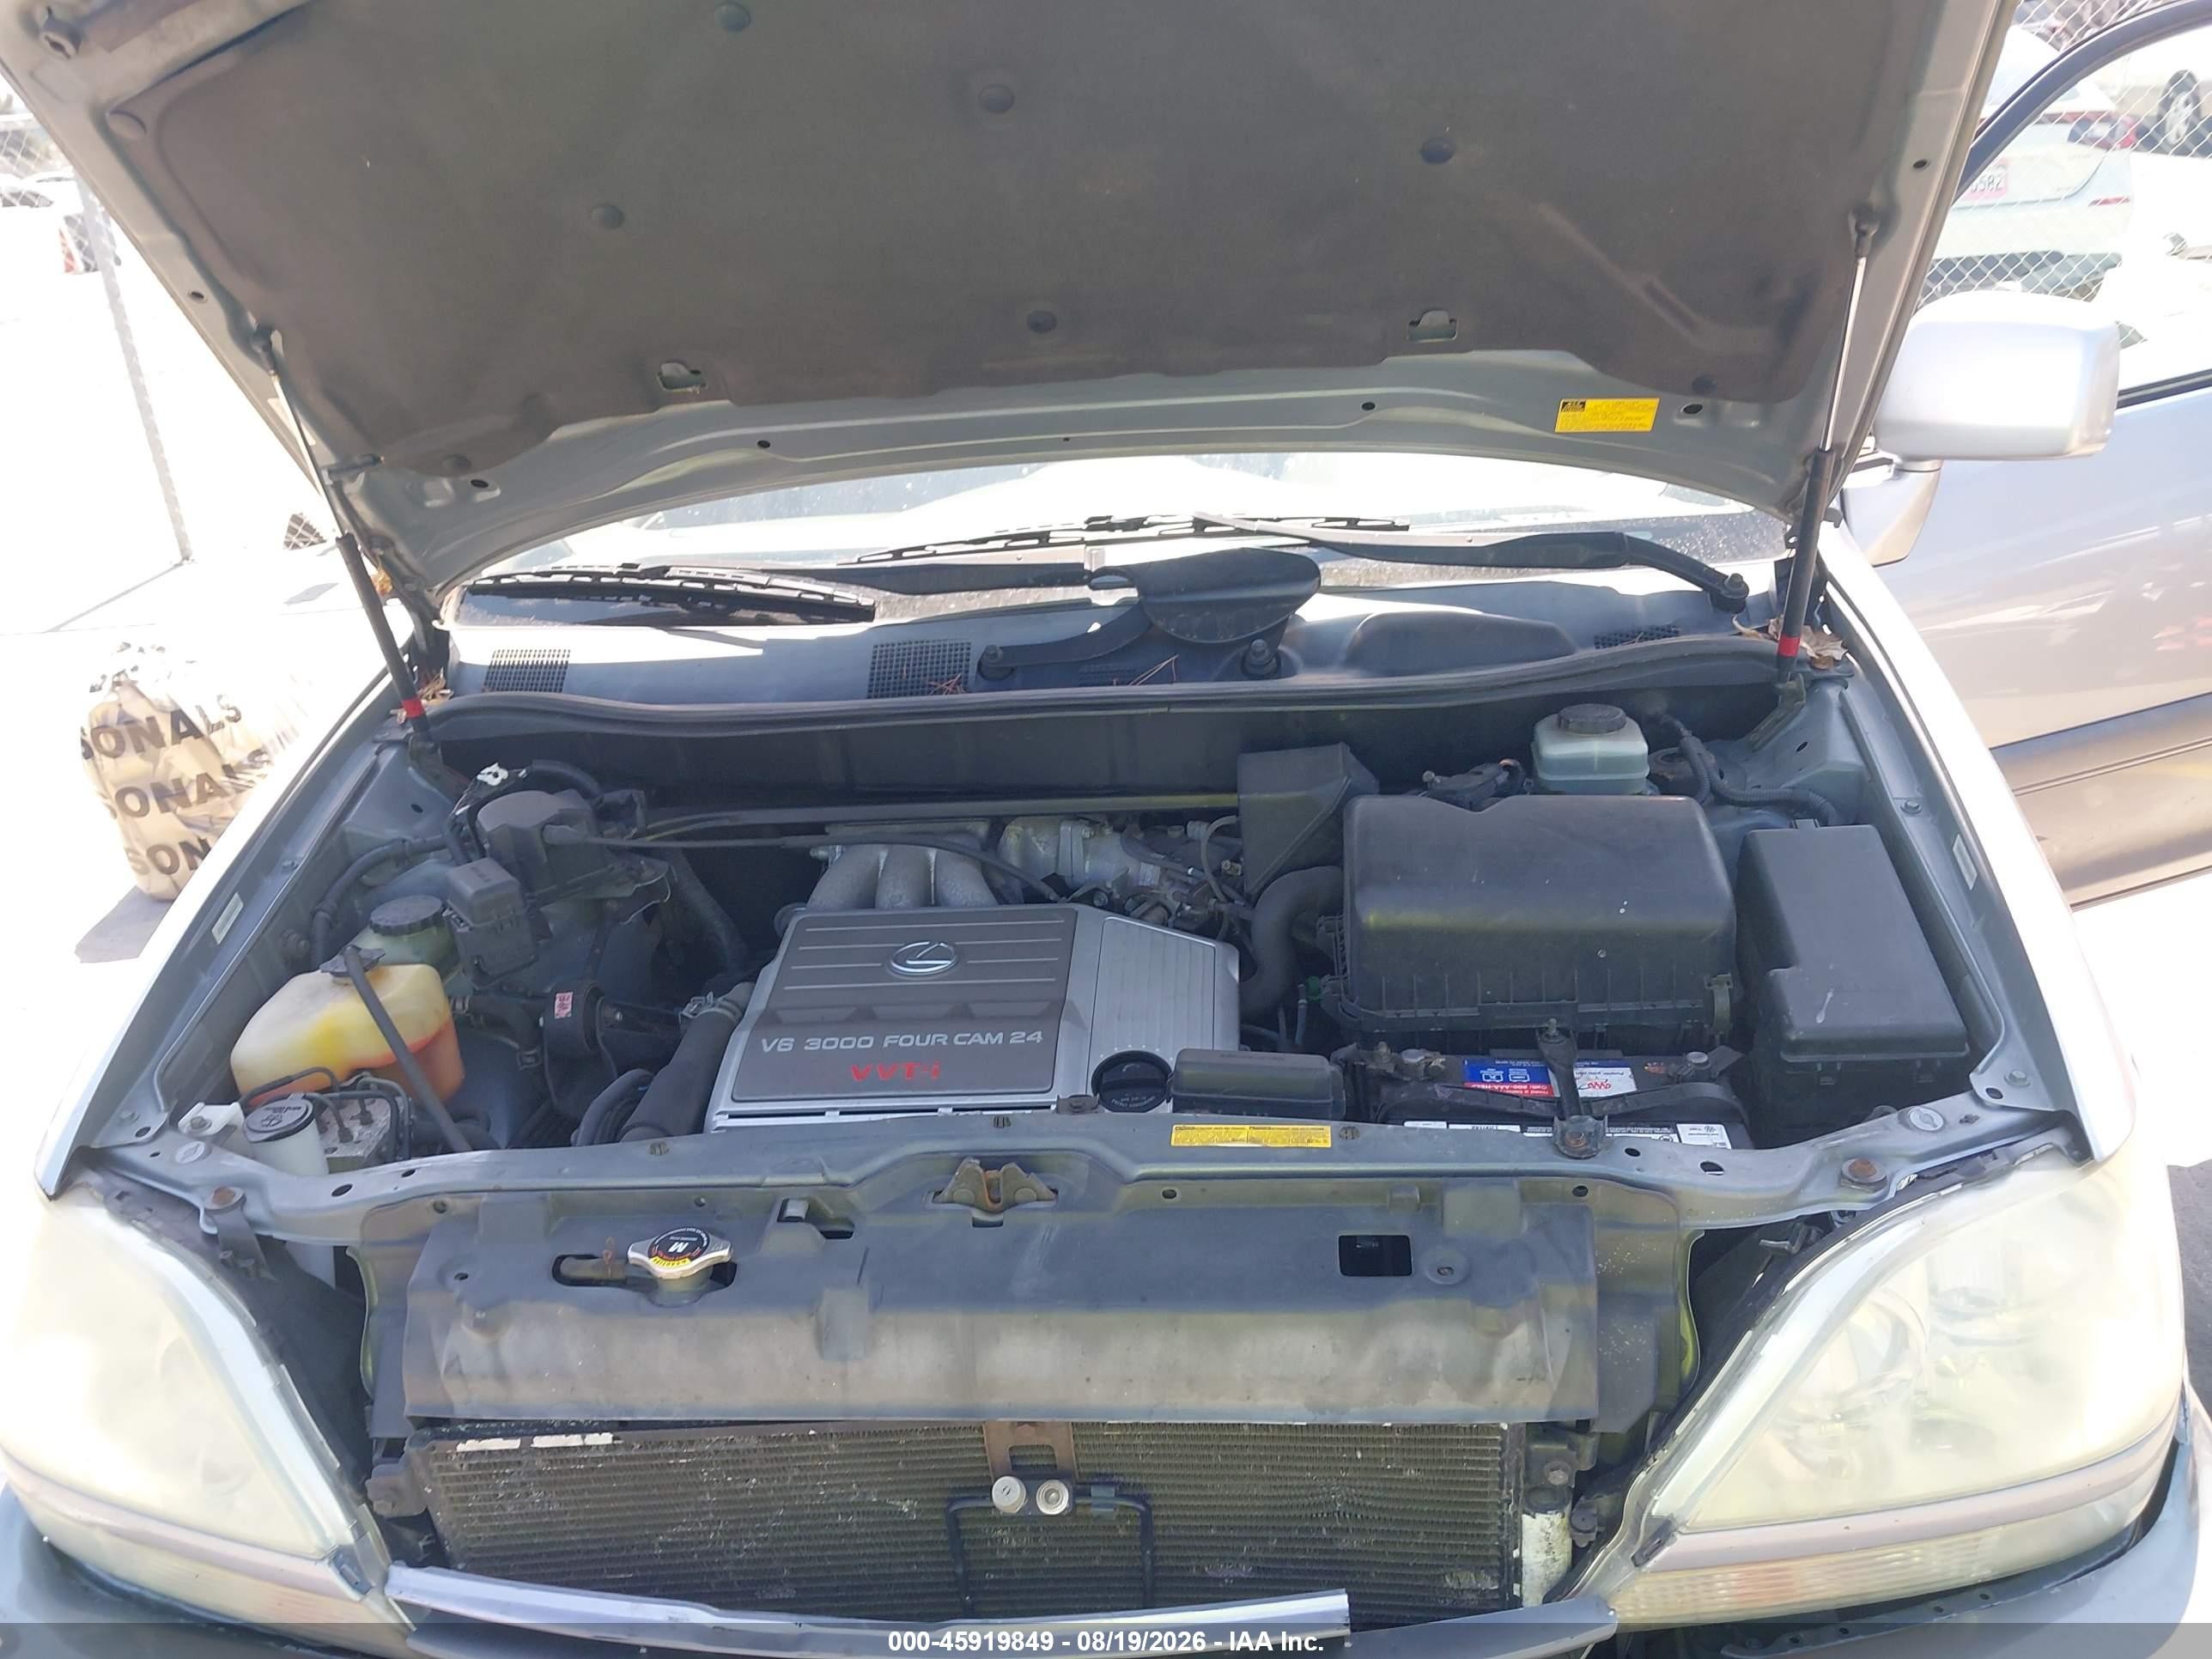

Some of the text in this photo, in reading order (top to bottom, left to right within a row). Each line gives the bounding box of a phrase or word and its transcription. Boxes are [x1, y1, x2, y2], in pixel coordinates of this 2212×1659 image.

[762, 1030, 1044, 1052] V6 3000 FOUR CAM 24
